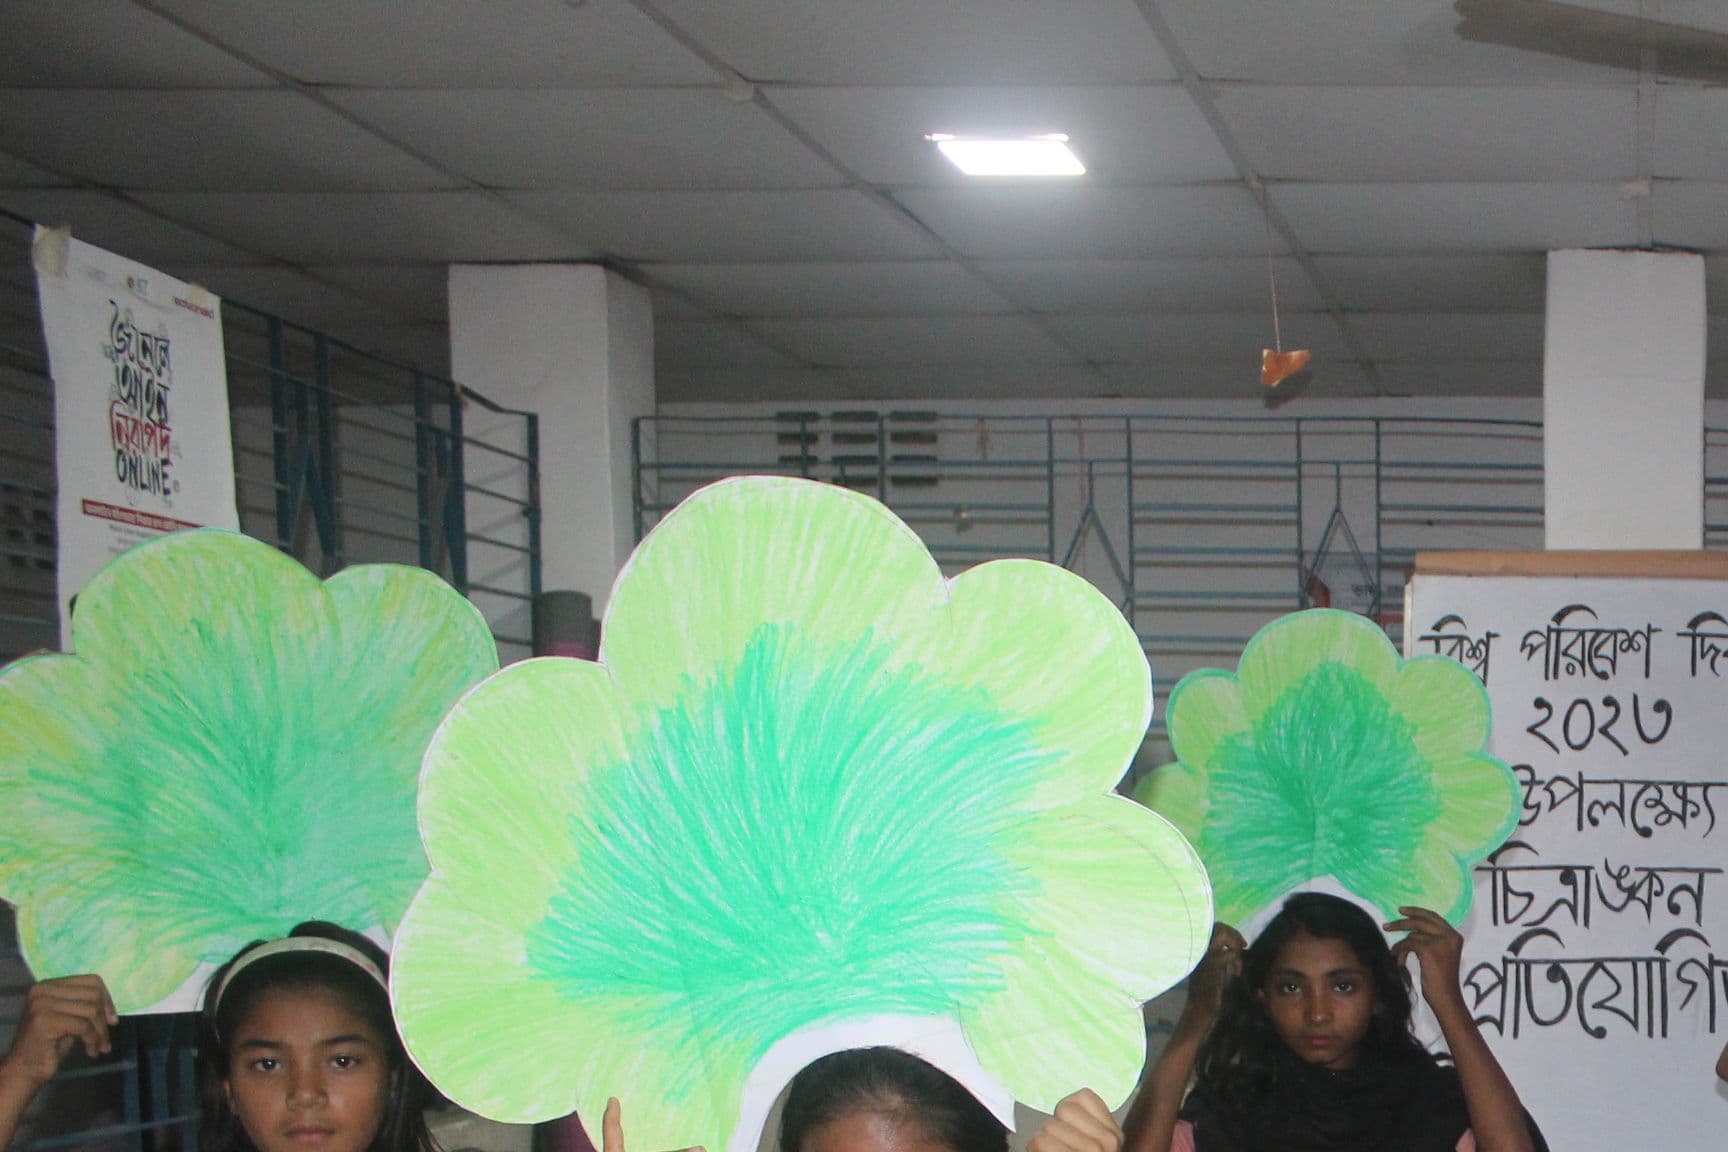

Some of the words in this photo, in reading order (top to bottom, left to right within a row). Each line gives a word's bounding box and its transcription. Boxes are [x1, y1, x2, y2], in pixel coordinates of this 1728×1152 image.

[116, 448, 172, 496] ONLINE
[1519, 604, 1663, 681] পরিবেশ
[1526, 693, 1673, 757] ২০২৩
[1475, 840, 1725, 930] চিত্রাঙ্কন
